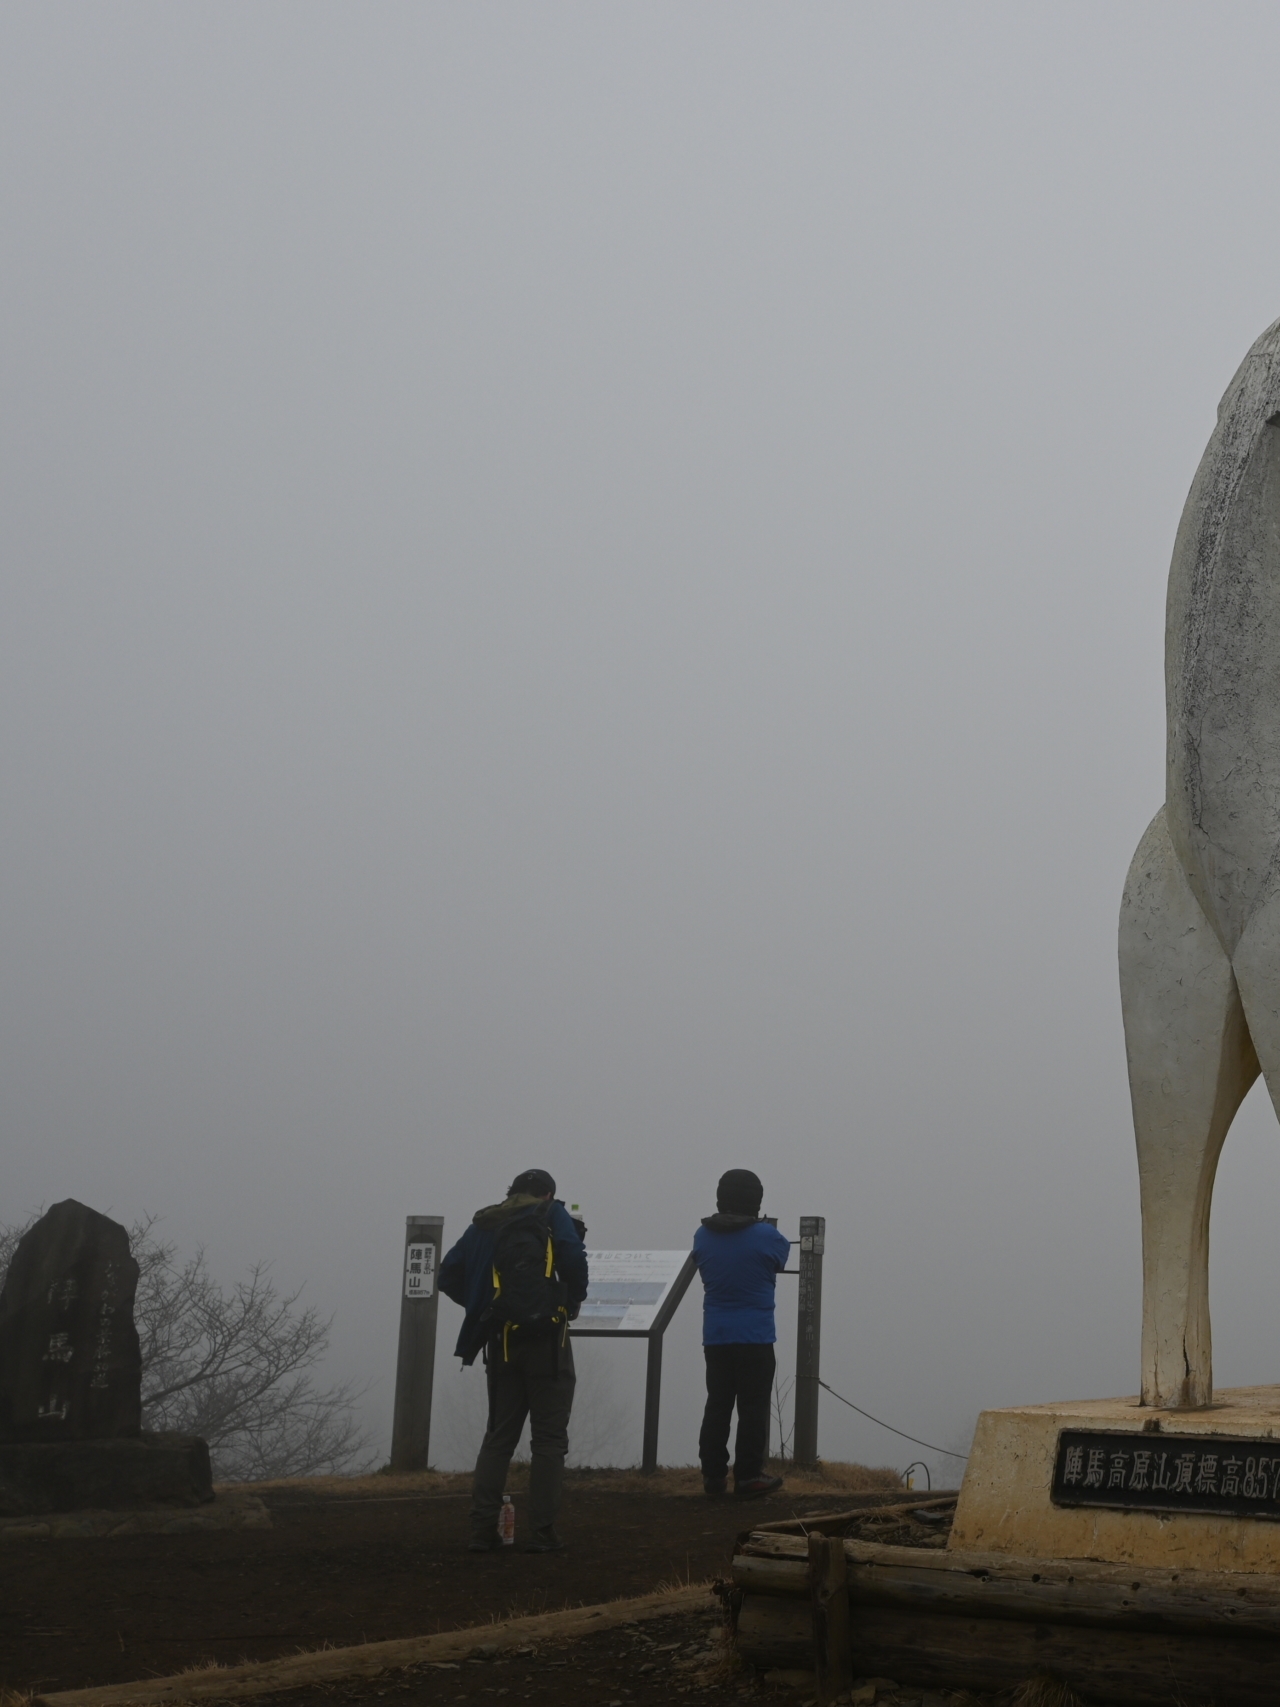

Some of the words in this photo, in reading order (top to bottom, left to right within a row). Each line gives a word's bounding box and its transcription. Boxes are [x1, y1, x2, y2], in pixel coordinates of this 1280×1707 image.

[409, 1248, 423, 1288] 陣馬山
[37, 1278, 79, 1421] 陣馬山
